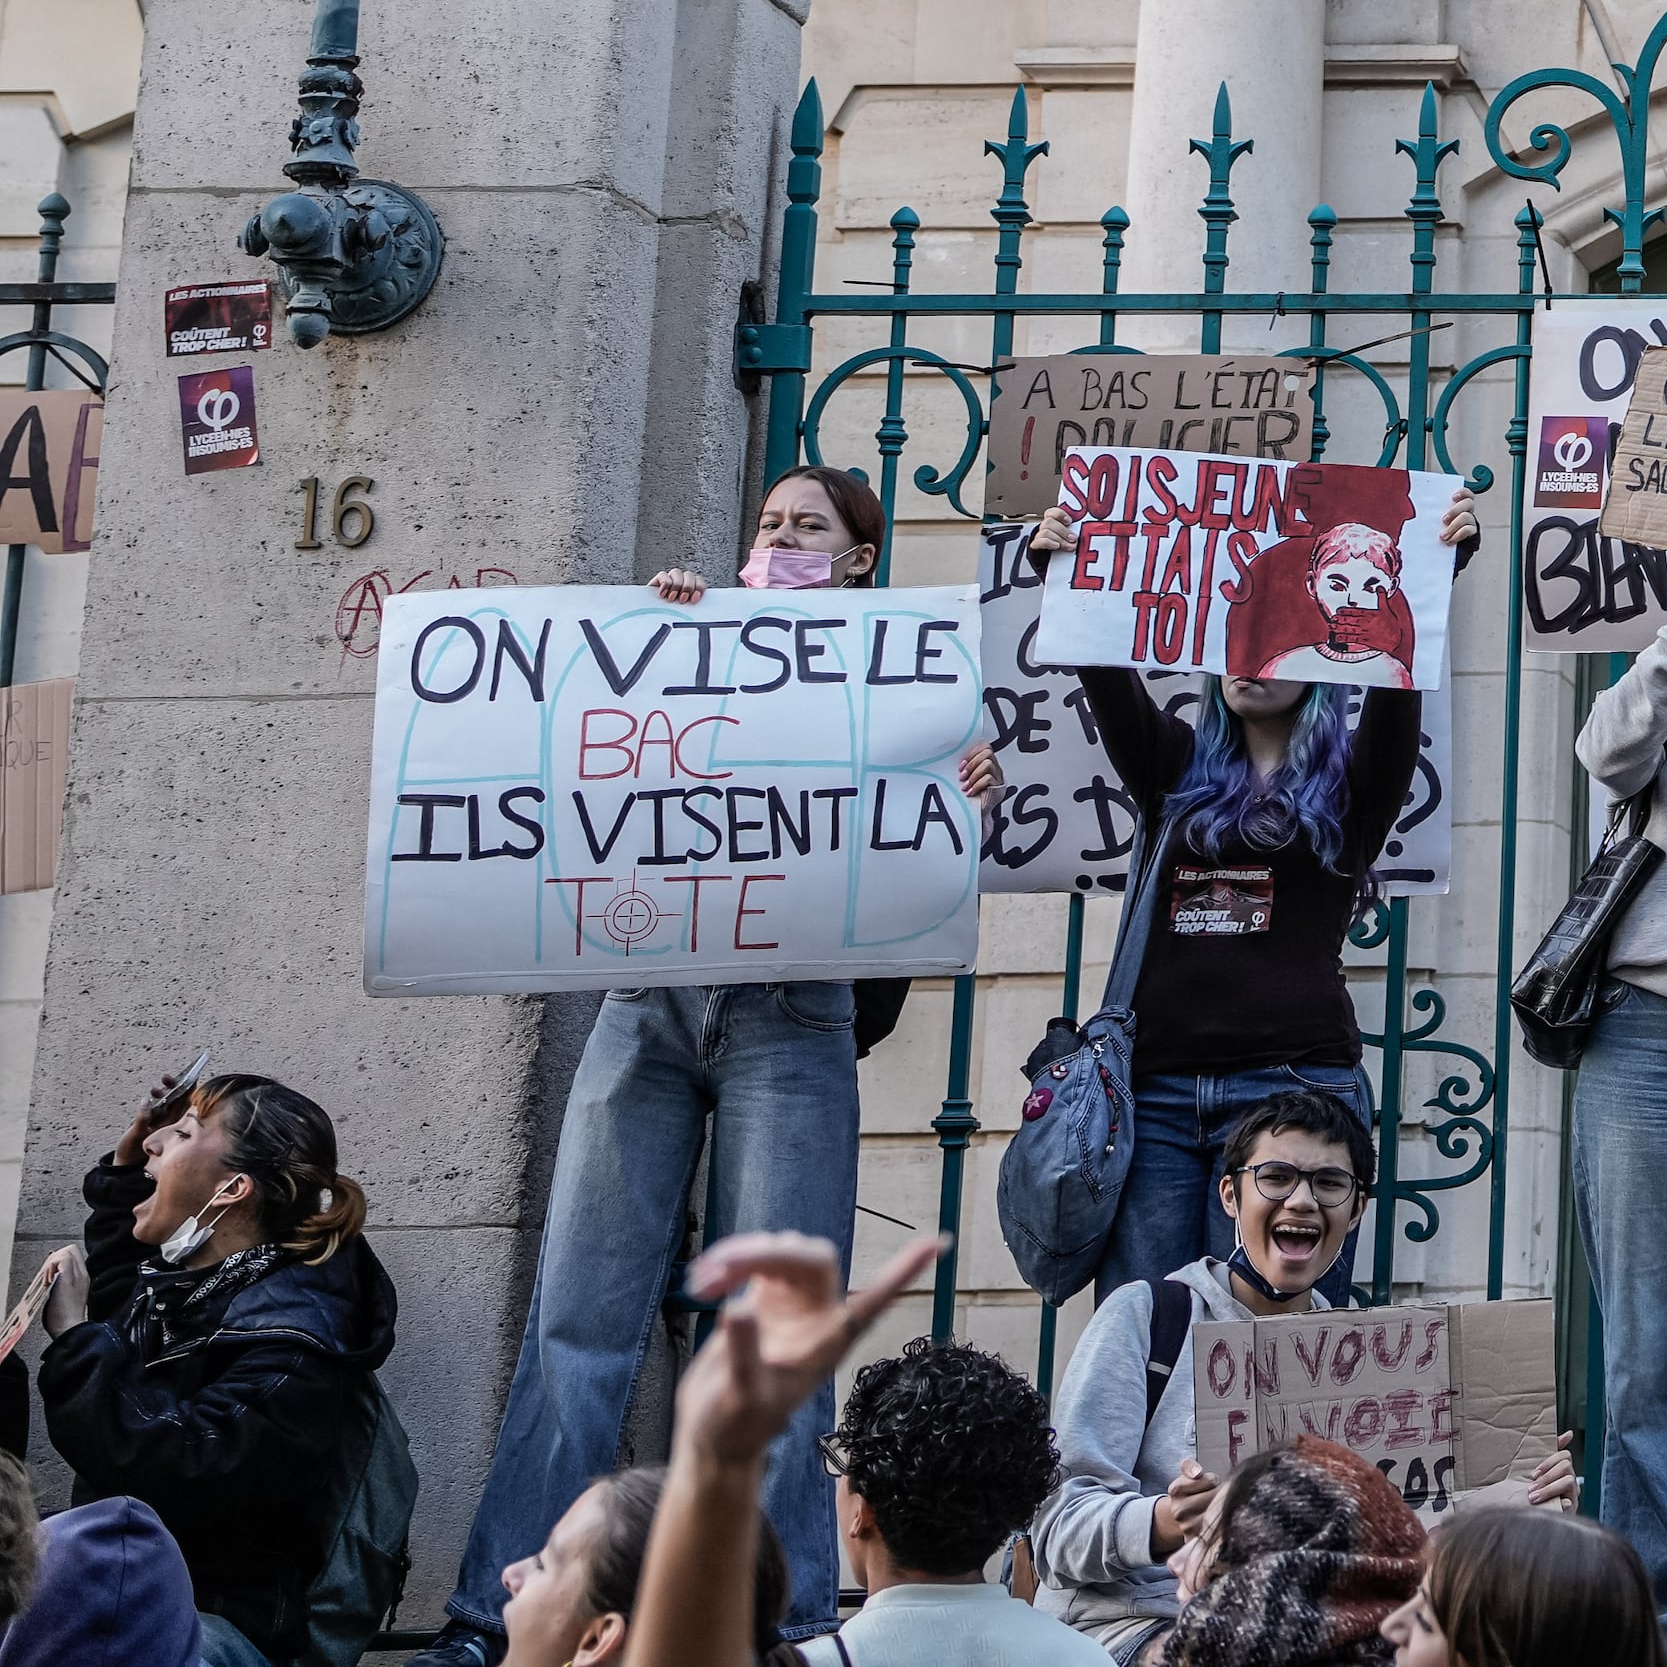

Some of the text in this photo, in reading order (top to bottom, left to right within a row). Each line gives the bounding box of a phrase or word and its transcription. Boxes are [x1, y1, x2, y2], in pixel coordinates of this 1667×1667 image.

[169, 283, 267, 302] LES ACTIONNAIRES
[171, 327, 232, 342] COÛTENT
[172, 340, 206, 353] TROP
[1021, 361, 1310, 411] A BAS L'ÉTAT
[294, 476, 374, 549] 16
[1059, 453, 1323, 539] SOIS JEUNE
[1070, 521, 1138, 591] ET
[1140, 522, 1260, 603] TAIS
[411, 616, 552, 703] ON
[578, 618, 847, 698] VISE
[865, 619, 960, 684] LE
[1131, 592, 1213, 668] TOI
[579, 709, 741, 781] BAC
[391, 778, 964, 866] ILS VISENT LA
[1178, 870, 1270, 881] LES ACTIONNAIRES
[1174, 921, 1205, 933] TROP
[1175, 908, 1231, 921] COÛTENT
[1207, 1319, 1448, 1400] ON VOUS
